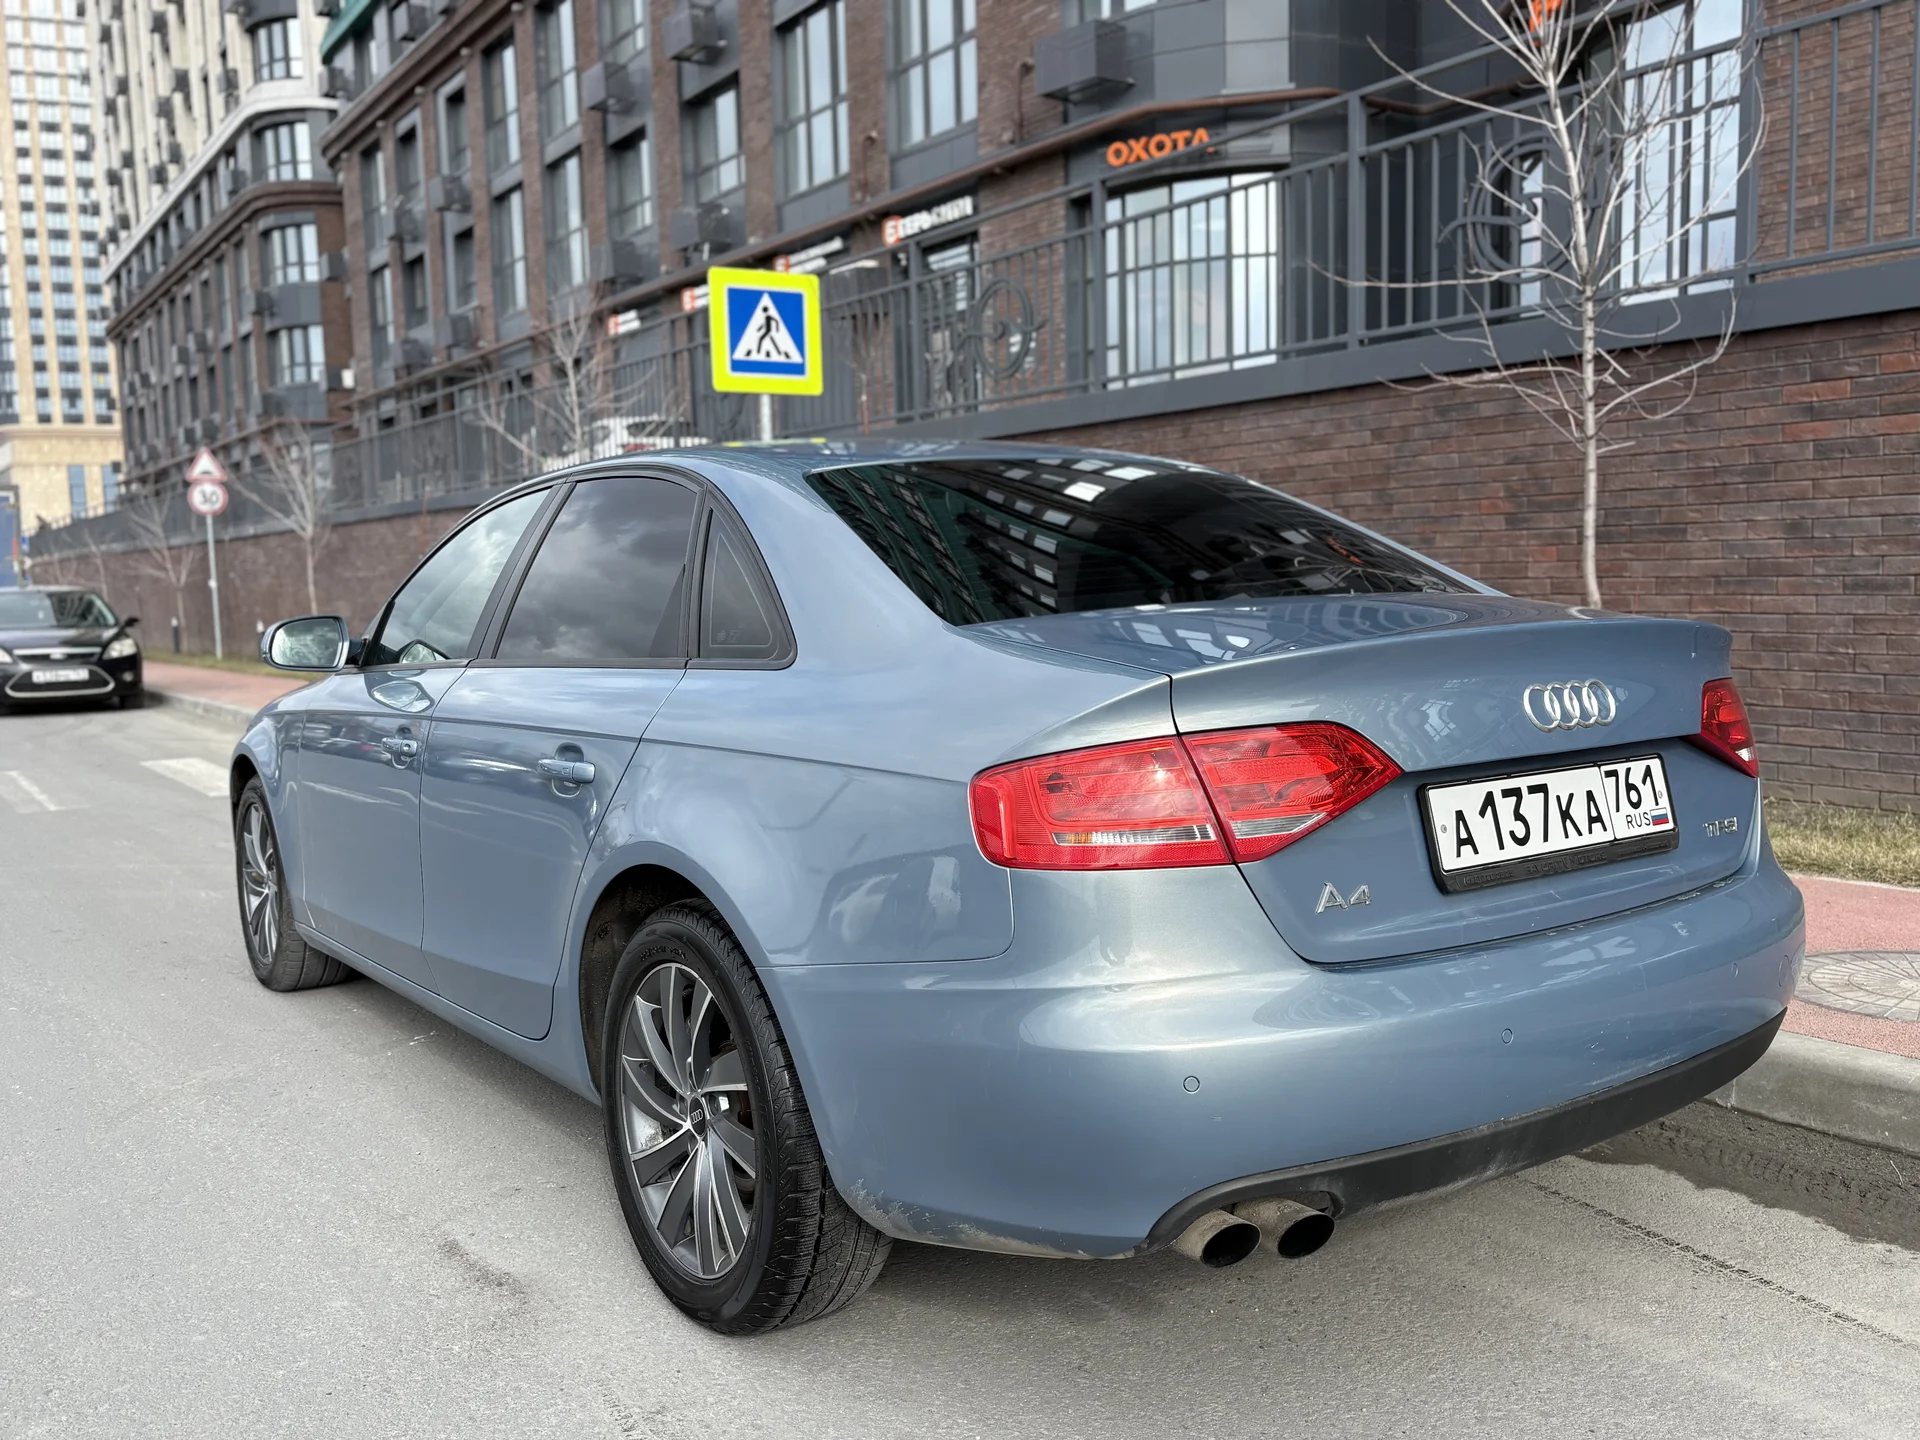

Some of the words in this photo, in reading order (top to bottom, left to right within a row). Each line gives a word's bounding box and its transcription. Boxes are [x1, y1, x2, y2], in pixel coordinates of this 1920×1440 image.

[1106, 127, 1215, 168] ОХОТА
[1604, 763, 1661, 814] 761
[1626, 808, 1652, 830] RUS
[1315, 881, 1372, 915] A4
